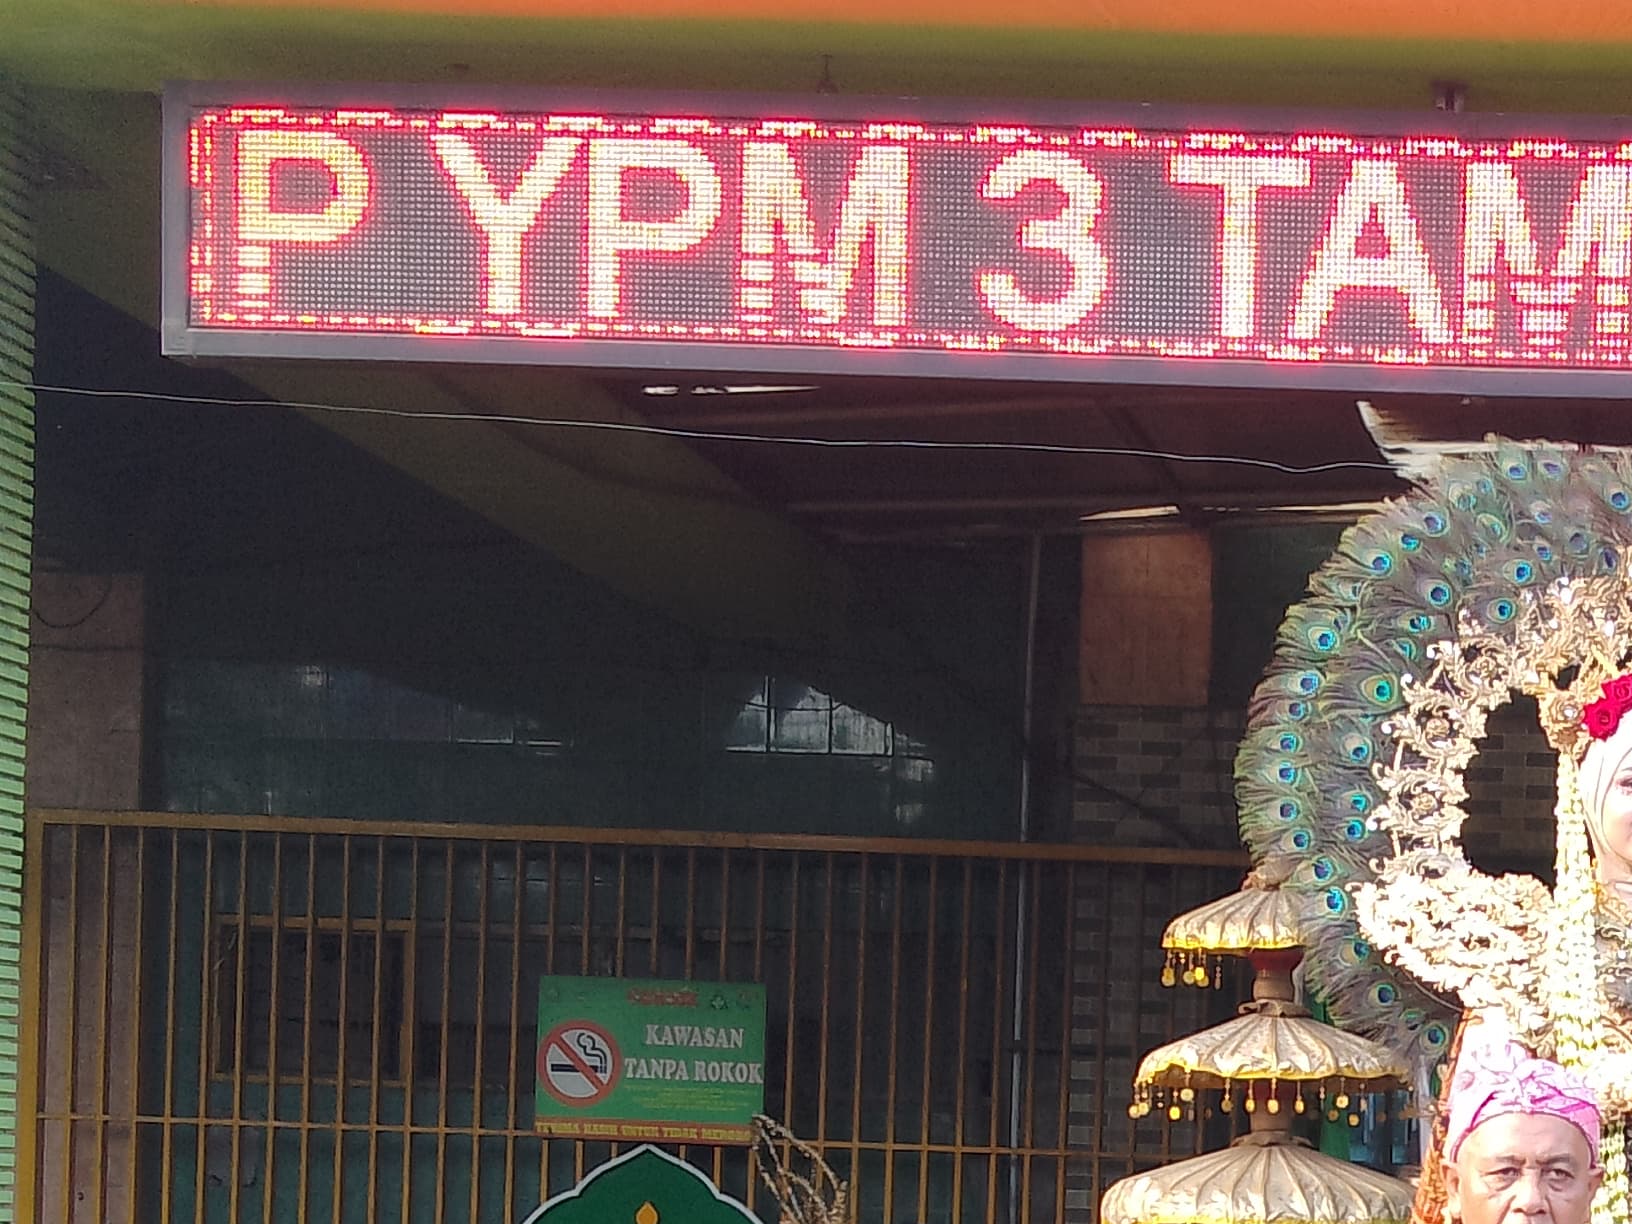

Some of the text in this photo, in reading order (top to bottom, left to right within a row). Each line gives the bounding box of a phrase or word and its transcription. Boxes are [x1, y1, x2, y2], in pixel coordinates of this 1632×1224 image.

[236, 128, 372, 304] P
[432, 132, 912, 328] YPM
[976, 148, 1111, 332] 3
[645, 1024, 745, 1049] KAWASAN
[624, 1058, 763, 1085] TANPA ROKOK
